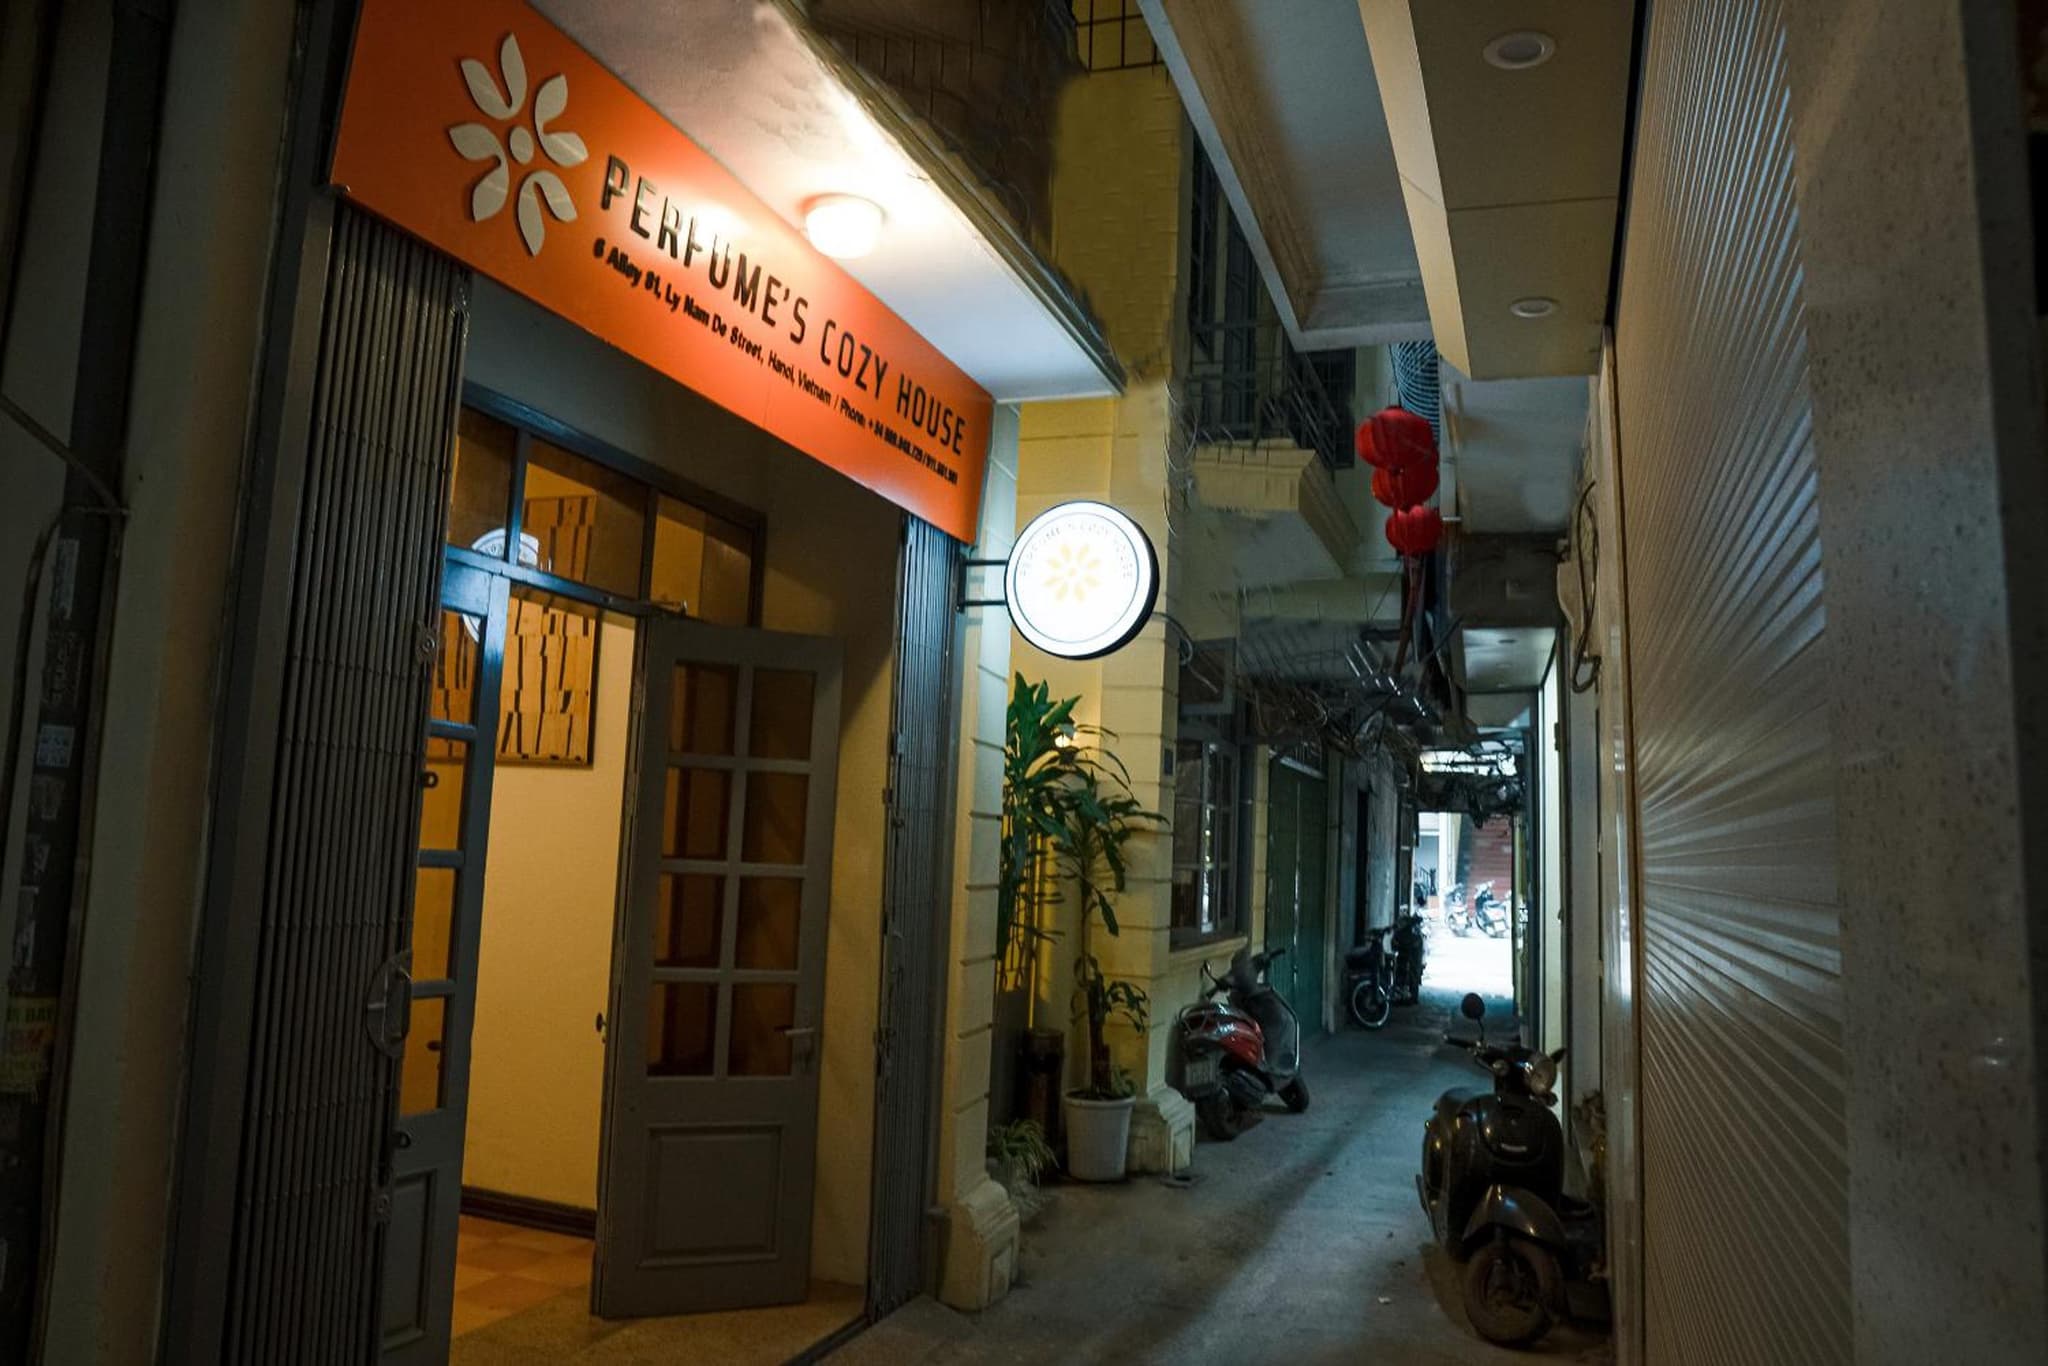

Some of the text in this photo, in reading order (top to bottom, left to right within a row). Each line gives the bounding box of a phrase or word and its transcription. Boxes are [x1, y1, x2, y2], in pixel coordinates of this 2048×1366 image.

[601, 155, 808, 345] PERFUME'S
[820, 319, 888, 399] COZY
[897, 373, 965, 455] HOUSE
[606, 246, 642, 288] Alley
[665, 282, 681, 313] Ly
[683, 294, 709, 327] Nam
[712, 313, 727, 336] De
[730, 326, 764, 366] Street,
[799, 369, 831, 406] Vietnam
